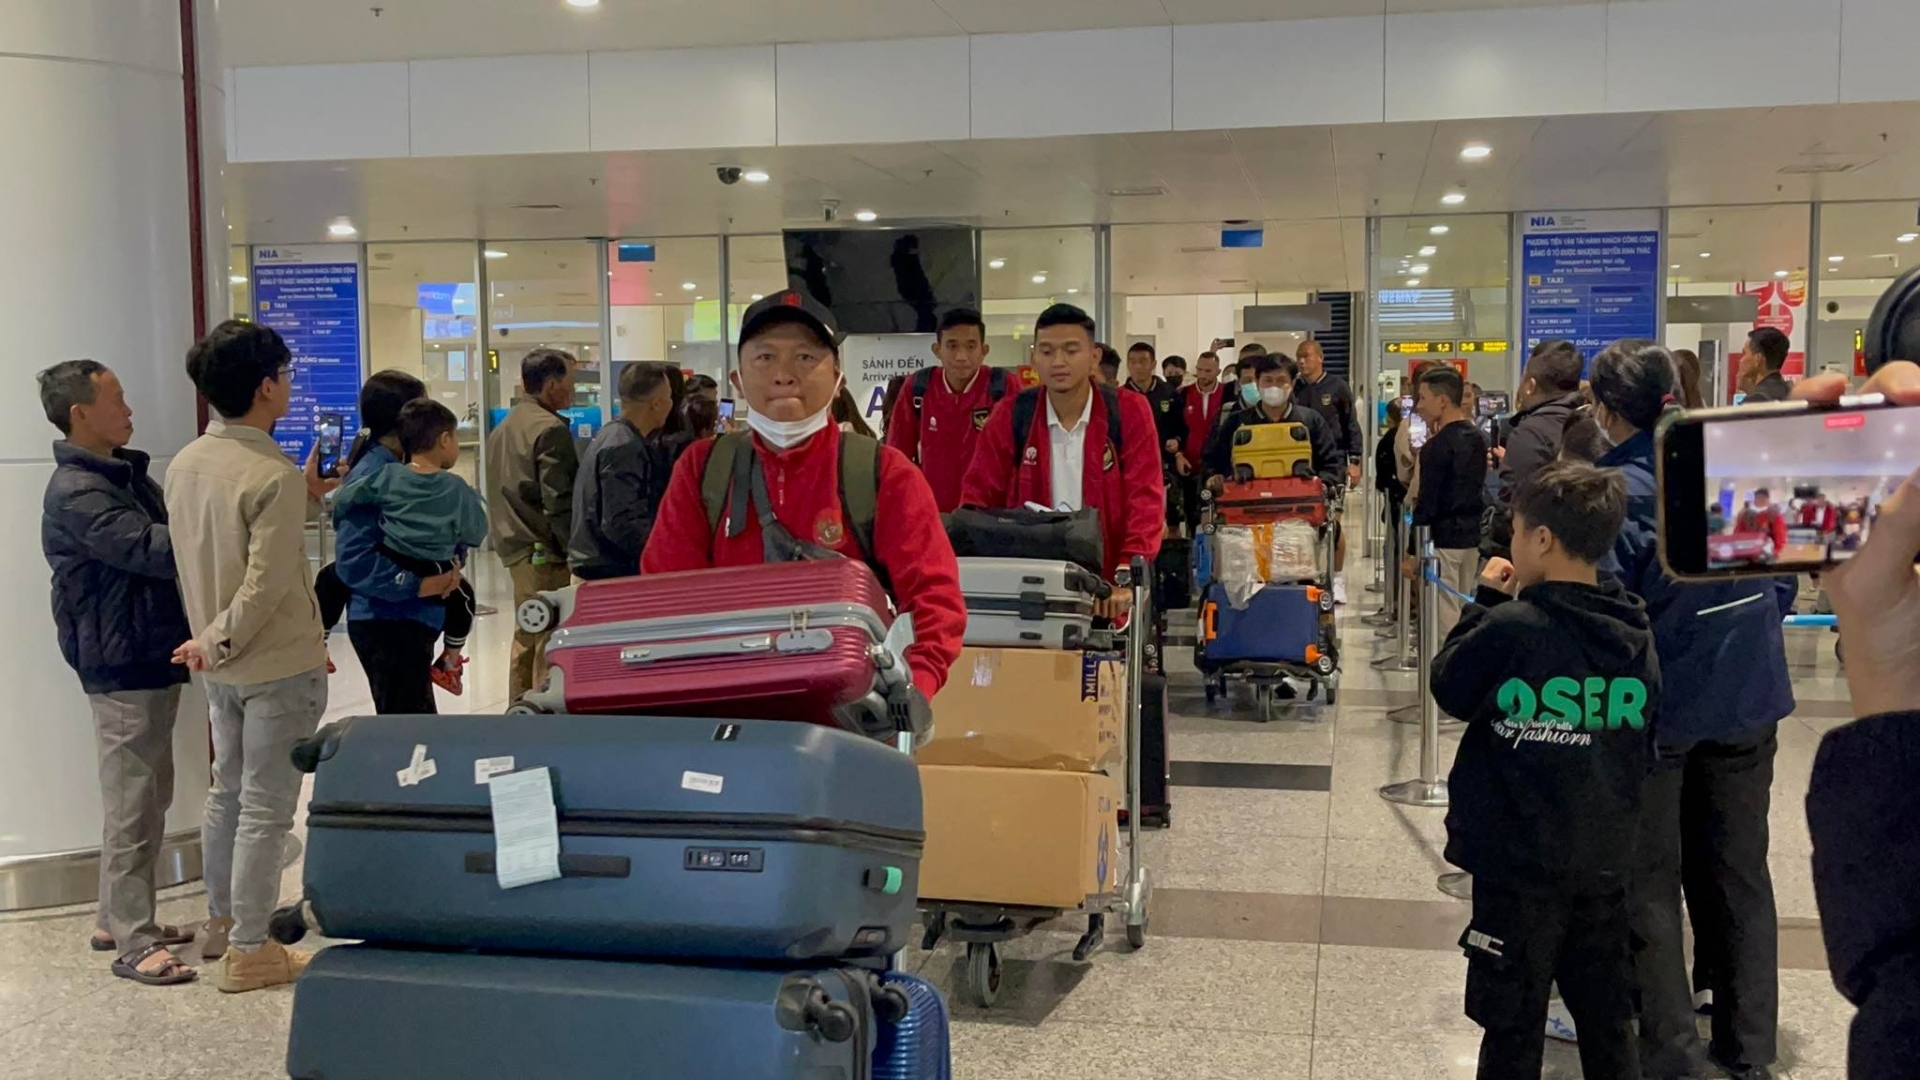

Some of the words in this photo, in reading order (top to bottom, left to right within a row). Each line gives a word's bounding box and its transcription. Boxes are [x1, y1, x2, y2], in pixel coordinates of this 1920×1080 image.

[1530, 216, 1556, 227] NIA
[259, 249, 279, 259] NIA
[897, 355, 924, 369] ĐẾN
[1085, 650, 1097, 694] MILLS
